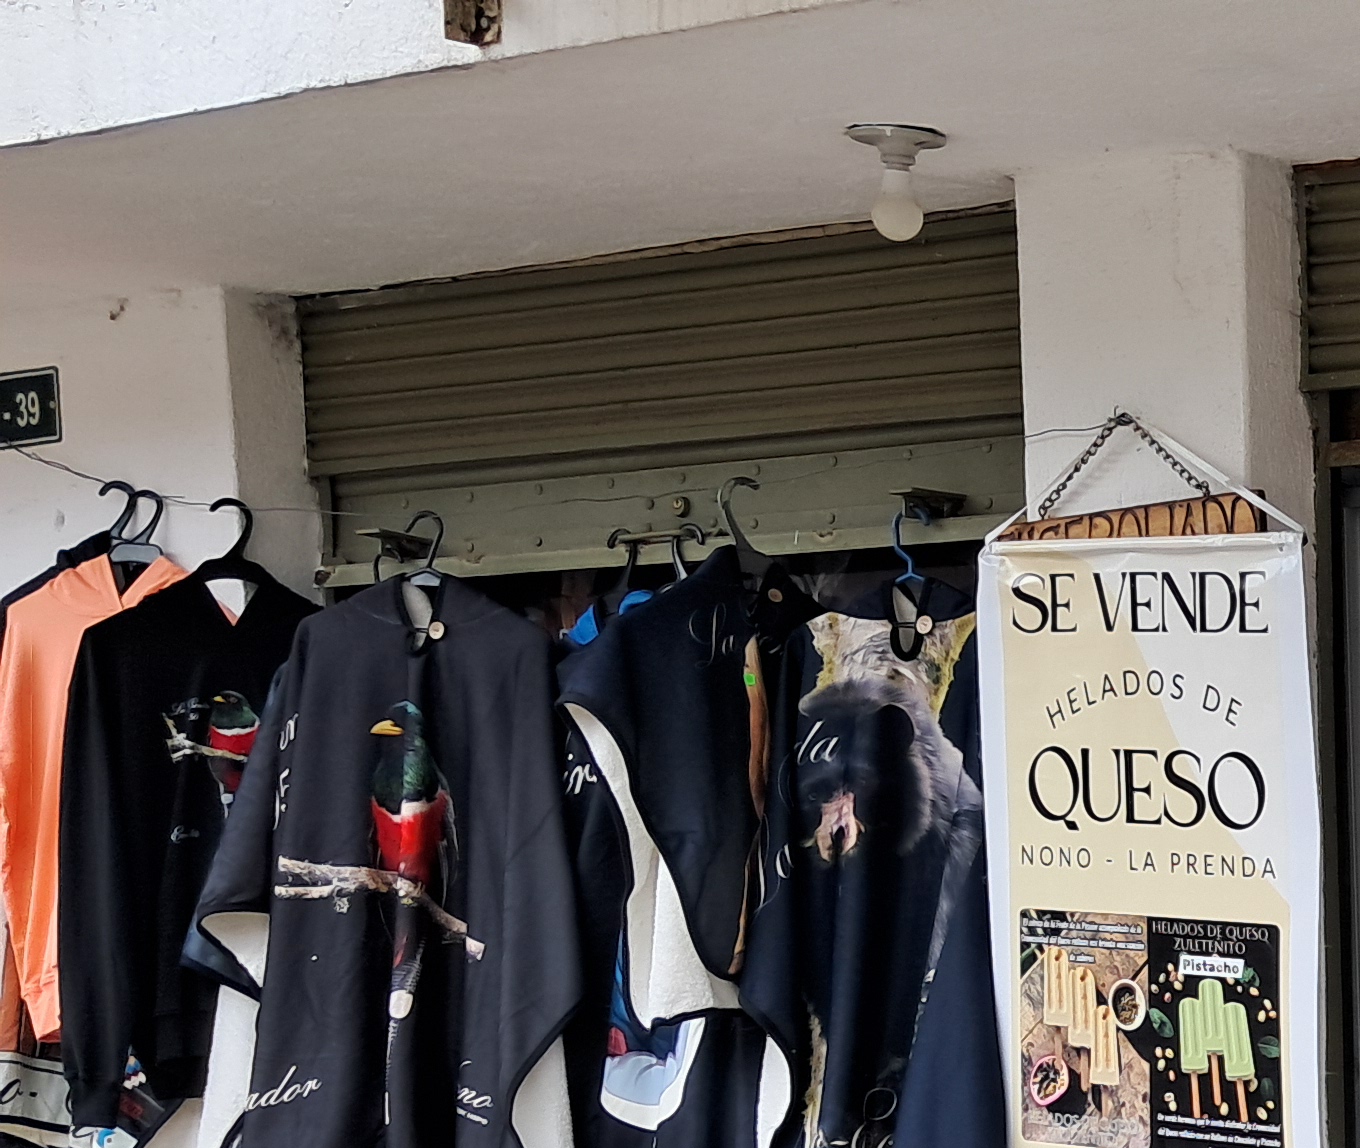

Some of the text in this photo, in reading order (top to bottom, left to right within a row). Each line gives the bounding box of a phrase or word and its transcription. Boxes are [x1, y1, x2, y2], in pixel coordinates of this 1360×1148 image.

[15, 391, 41, 428] 39
[1011, 570, 1270, 634] SE VENDE
[1046, 669, 1243, 729] HELADOS DE
[1028, 745, 1266, 831] QUESO
[1021, 845, 1277, 880] NONO LA PRENDA
[1182, 957, 1240, 975] Pistacho
